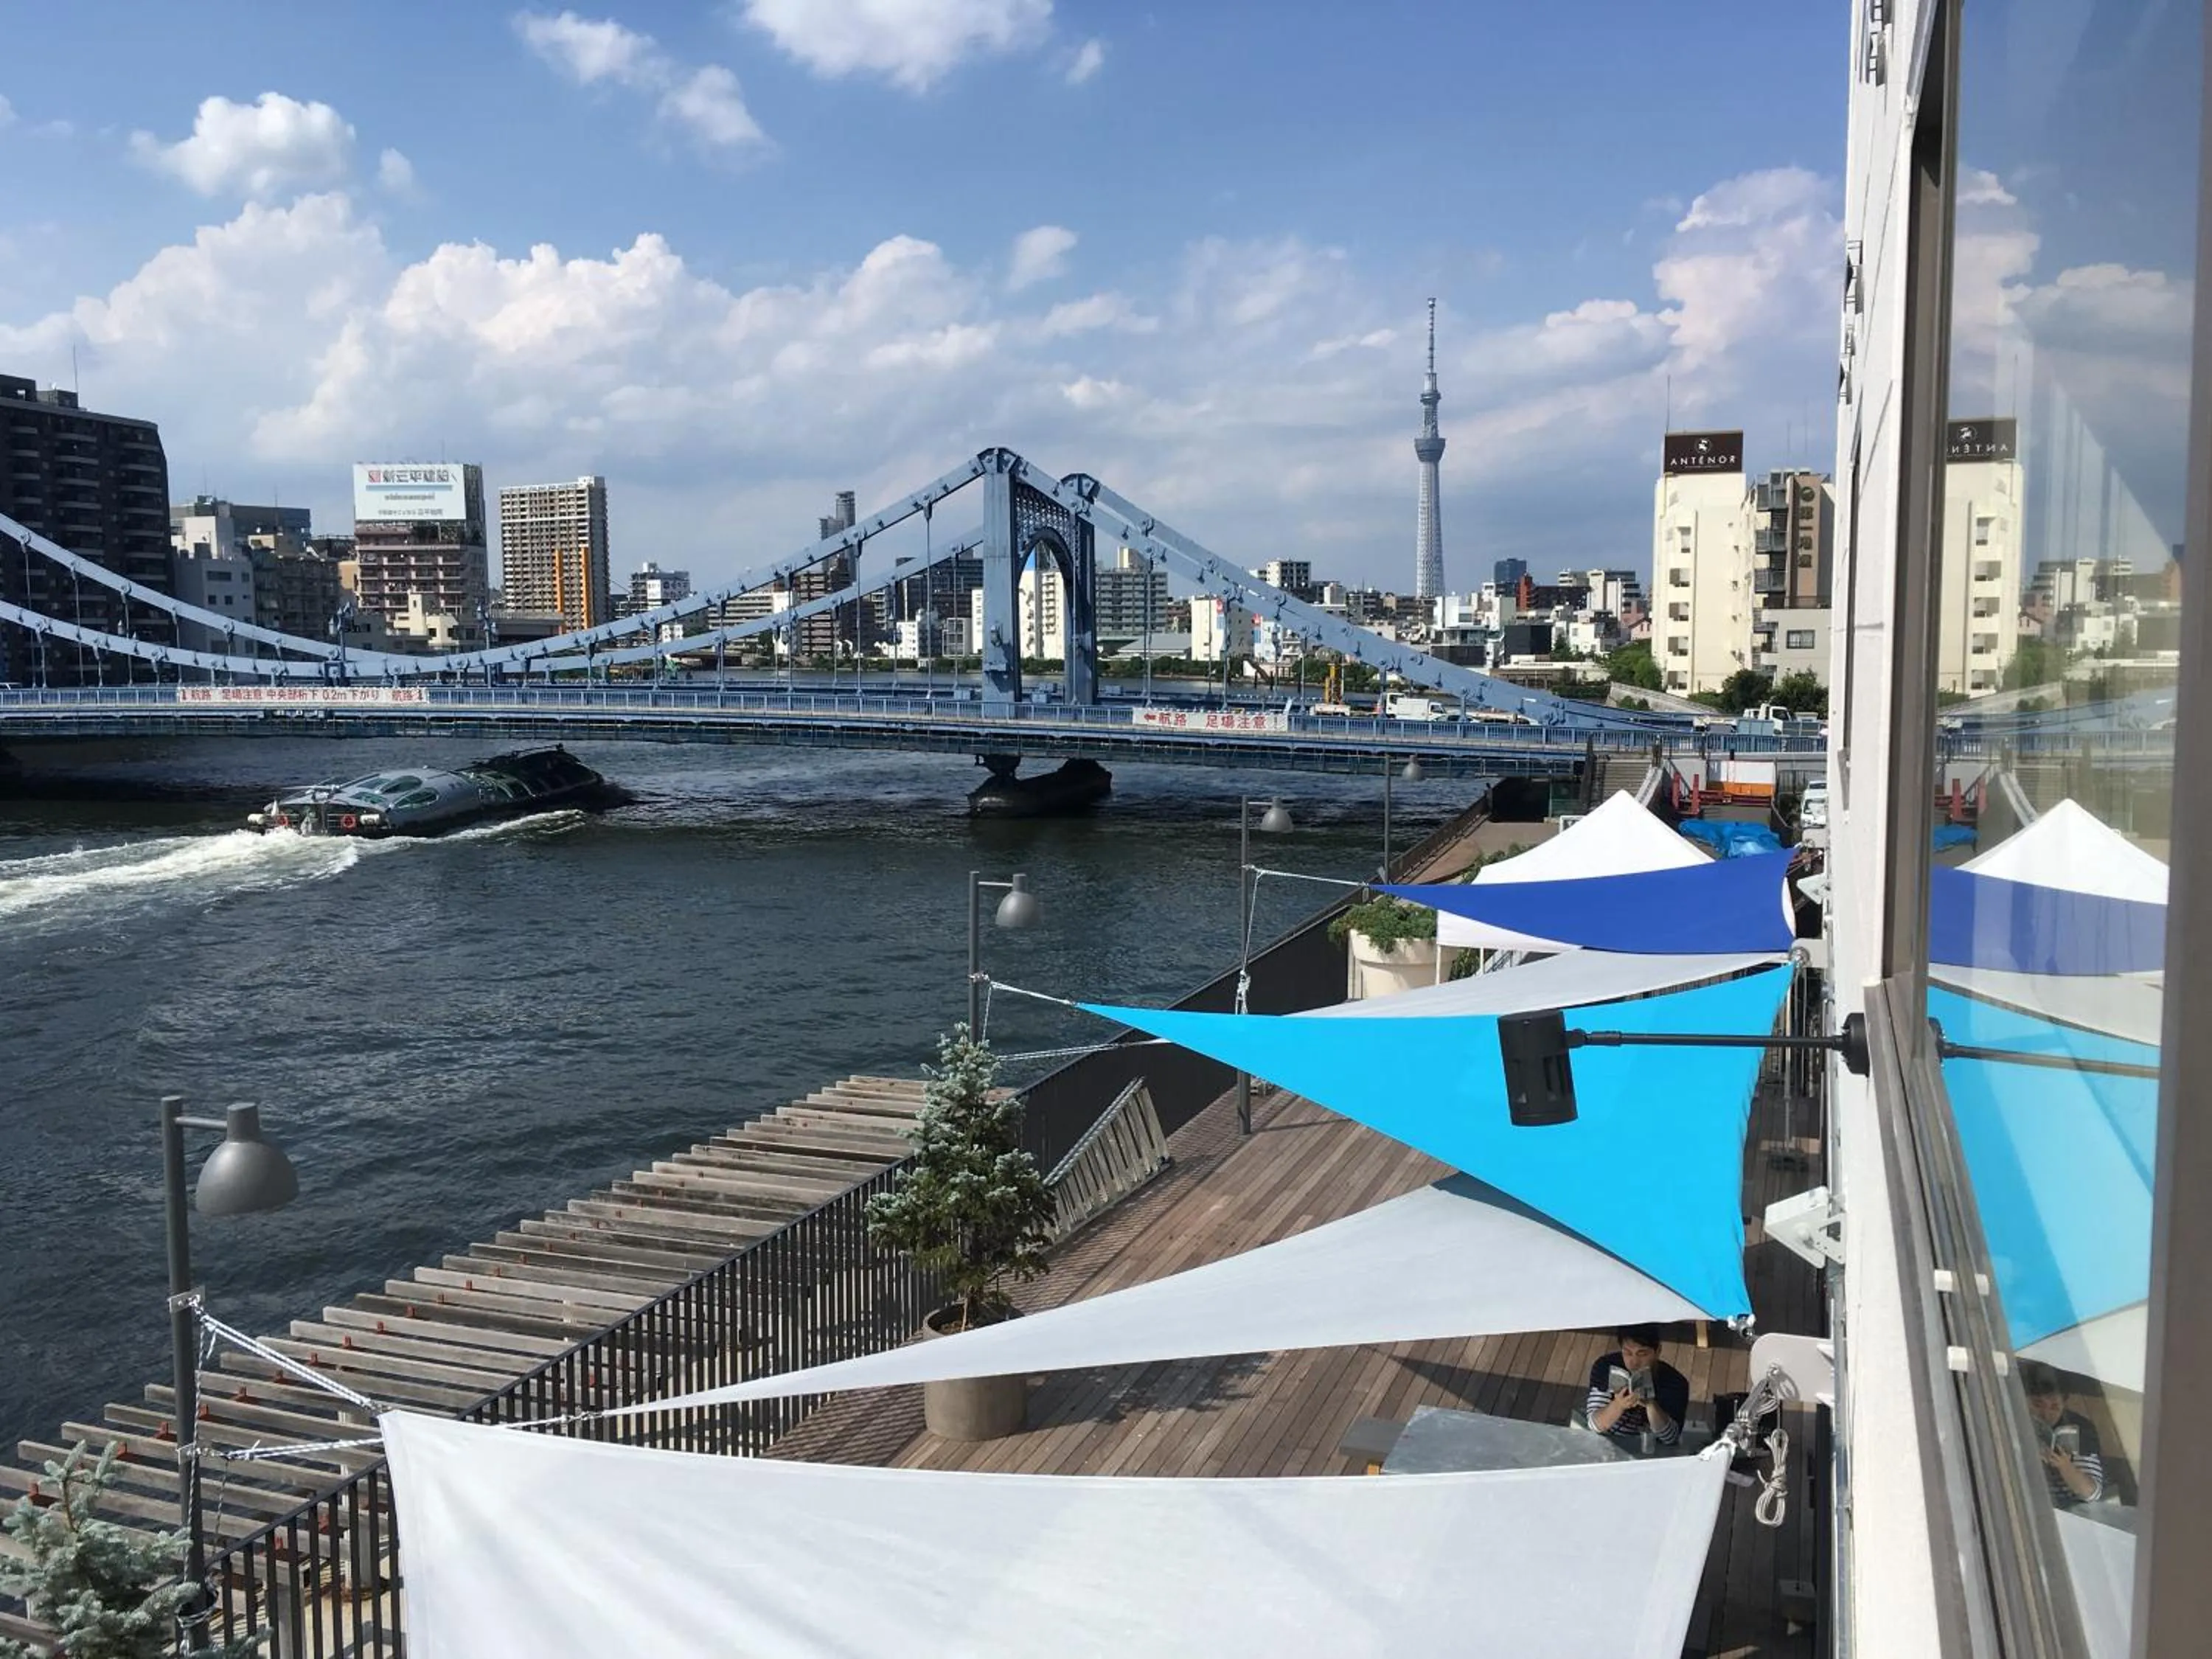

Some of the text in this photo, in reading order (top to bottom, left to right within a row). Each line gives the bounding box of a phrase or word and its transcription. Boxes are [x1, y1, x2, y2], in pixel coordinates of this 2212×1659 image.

[1158, 712, 1267, 728] 航路 足場注意
